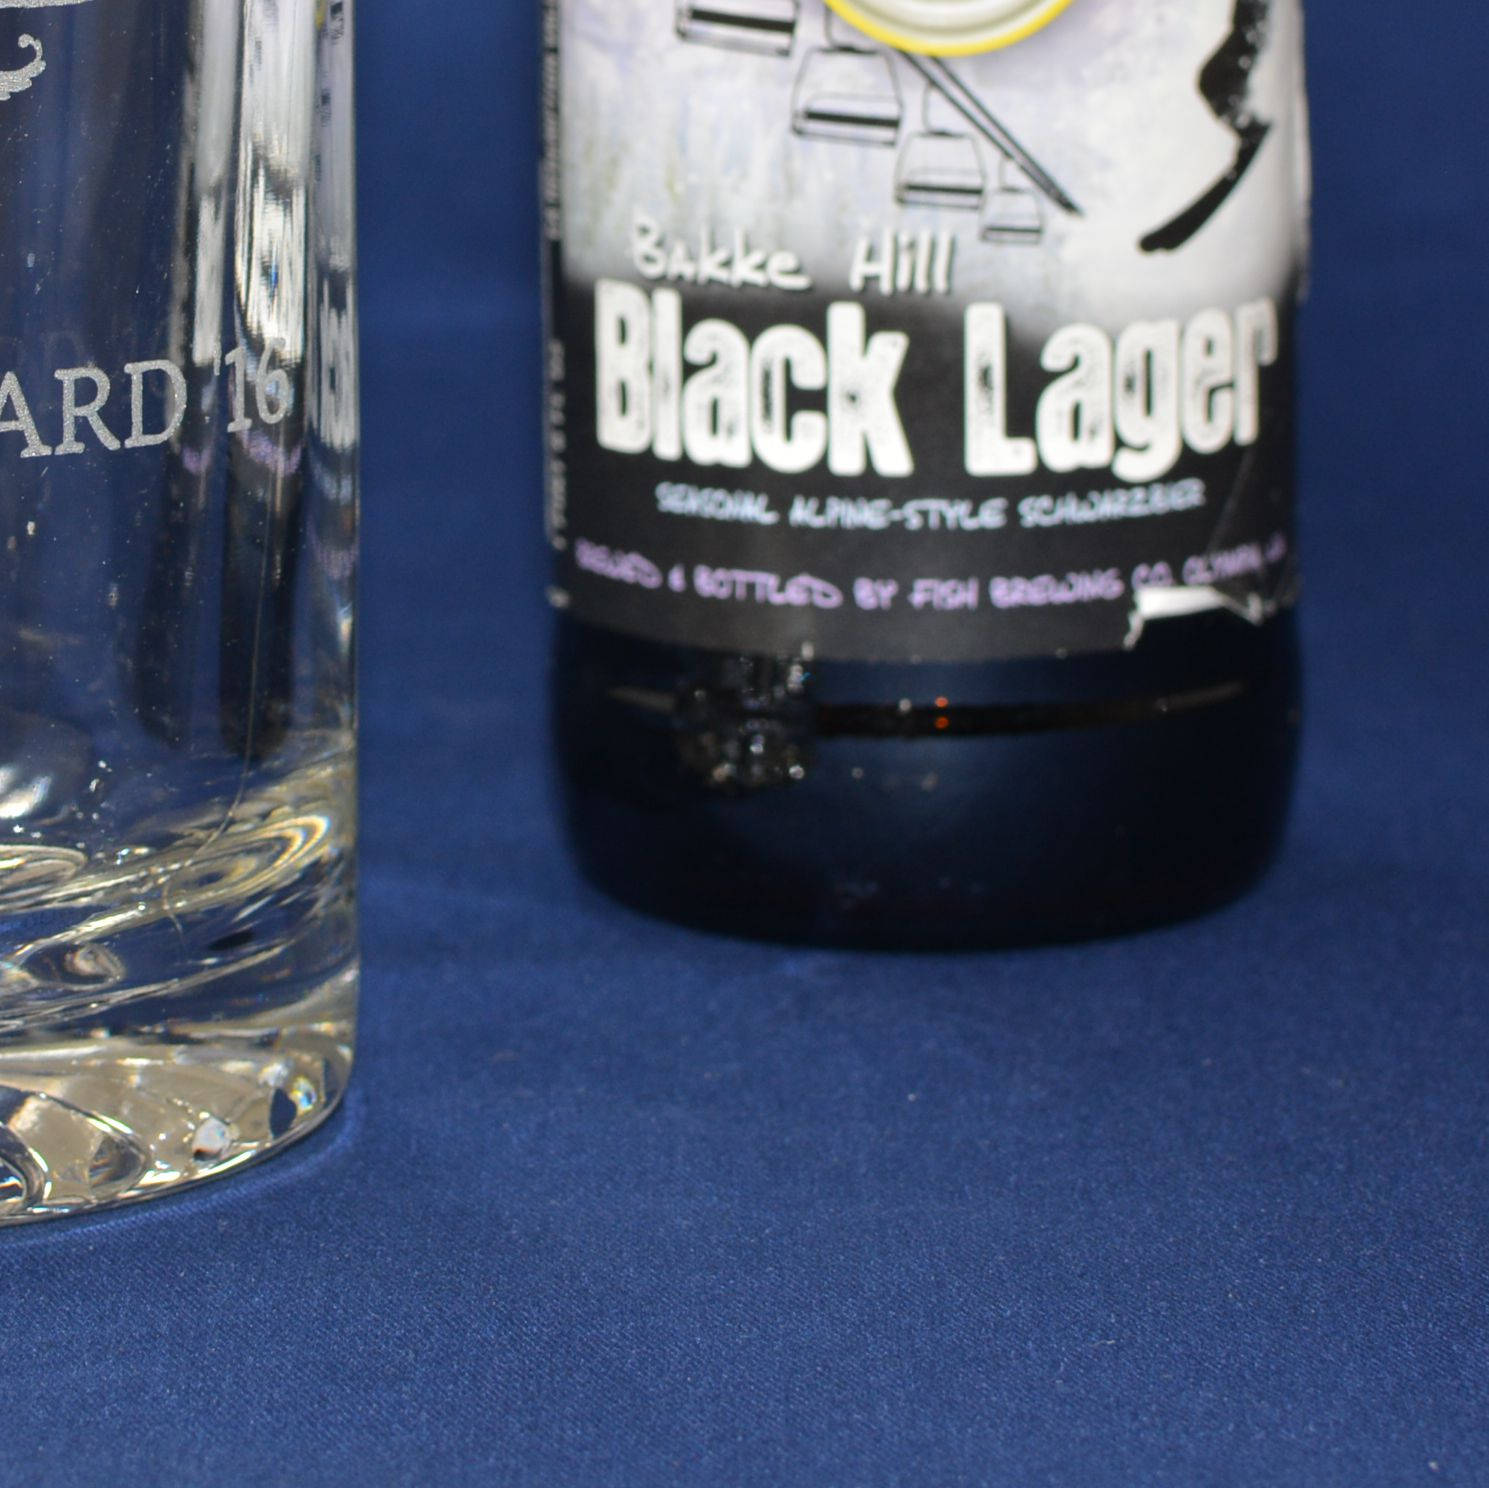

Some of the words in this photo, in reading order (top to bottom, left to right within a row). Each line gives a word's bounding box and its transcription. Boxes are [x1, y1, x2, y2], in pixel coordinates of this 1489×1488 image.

[848, 223, 957, 296] Hill
[594, 278, 914, 478] Black
[964, 296, 1279, 484] Lager
[693, 563, 844, 610] BOTTLED
[852, 576, 899, 610] BY
[908, 576, 979, 610] FISH
[988, 567, 1125, 609] BREWING
